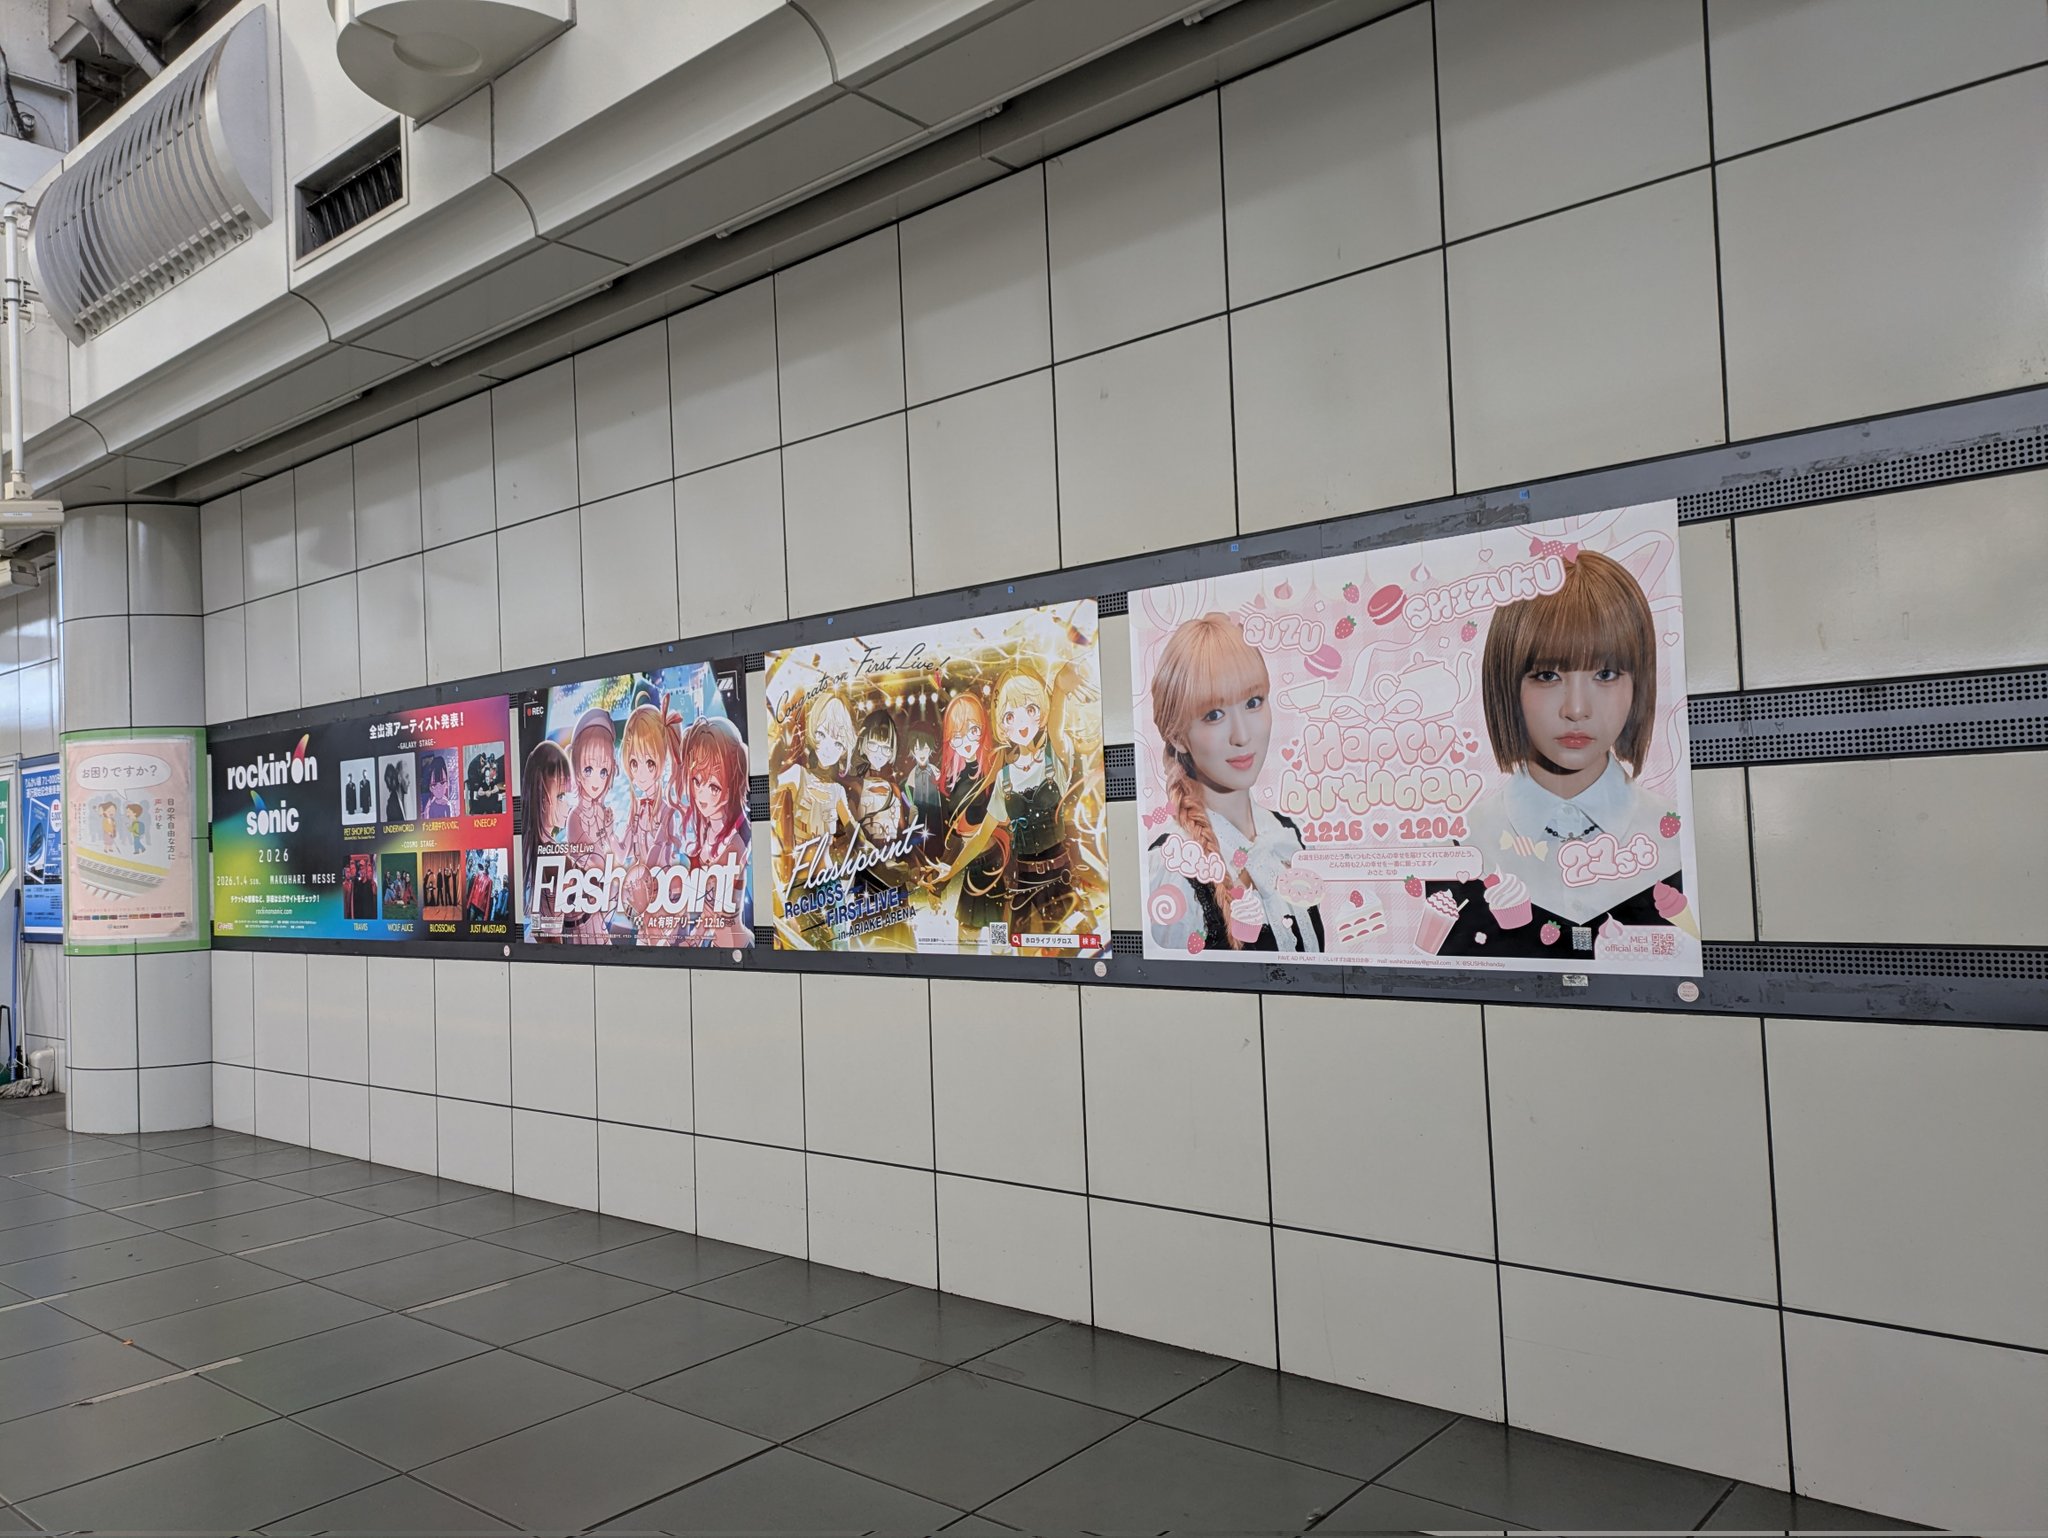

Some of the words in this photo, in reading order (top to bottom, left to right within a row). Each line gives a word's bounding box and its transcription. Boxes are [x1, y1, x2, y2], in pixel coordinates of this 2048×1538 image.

[1403, 556, 1566, 630] SHIZUKU
[1243, 613, 1325, 653] SUZU
[776, 674, 830, 724] Congrats
[855, 645, 900, 677] First
[896, 642, 951, 672] Live!
[532, 707, 544, 716] REC
[369, 711, 464, 740] 全出演アーティスト発表!
[1304, 719, 1456, 773] Happy
[82, 764, 158, 779] お困りですか?
[1280, 761, 1483, 820] birthday
[246, 799, 299, 835] sonic
[383, 823, 415, 834] UNDERWORLD
[473, 817, 498, 829] KNEECAP
[1303, 820, 1363, 843] 1216
[1399, 816, 1468, 840] 1204
[258, 848, 289, 863] 2026
[537, 843, 569, 855] ReGLOSS
[570, 843, 579, 854] 1st
[580, 843, 594, 853] Live
[785, 815, 925, 900] Flashpoint
[1161, 833, 1226, 884] 19th
[1557, 832, 1659, 888] 21st
[216, 876, 247, 886] 2026.1.4
[269, 874, 306, 884] MAKUHARI
[312, 873, 336, 884] MESSE
[784, 884, 844, 919] ReGLOSS
[826, 899, 864, 927] FIRST
[865, 887, 900, 916] LIVE
[429, 924, 456, 933] BLOSSOMS
[470, 924, 481, 933] JUST
[482, 924, 507, 934] MUSTARD
[648, 917, 657, 928] At
[658, 916, 703, 928] 有明アリーナ
[704, 916, 725, 928] 12.16
[847, 915, 883, 938] ARIAKE
[885, 905, 917, 926] ARENA
[1025, 937, 1051, 945] ホロライブ
[1082, 938, 1098, 946] 検索
[1605, 944, 1632, 953] official
[1634, 945, 1649, 953] site
